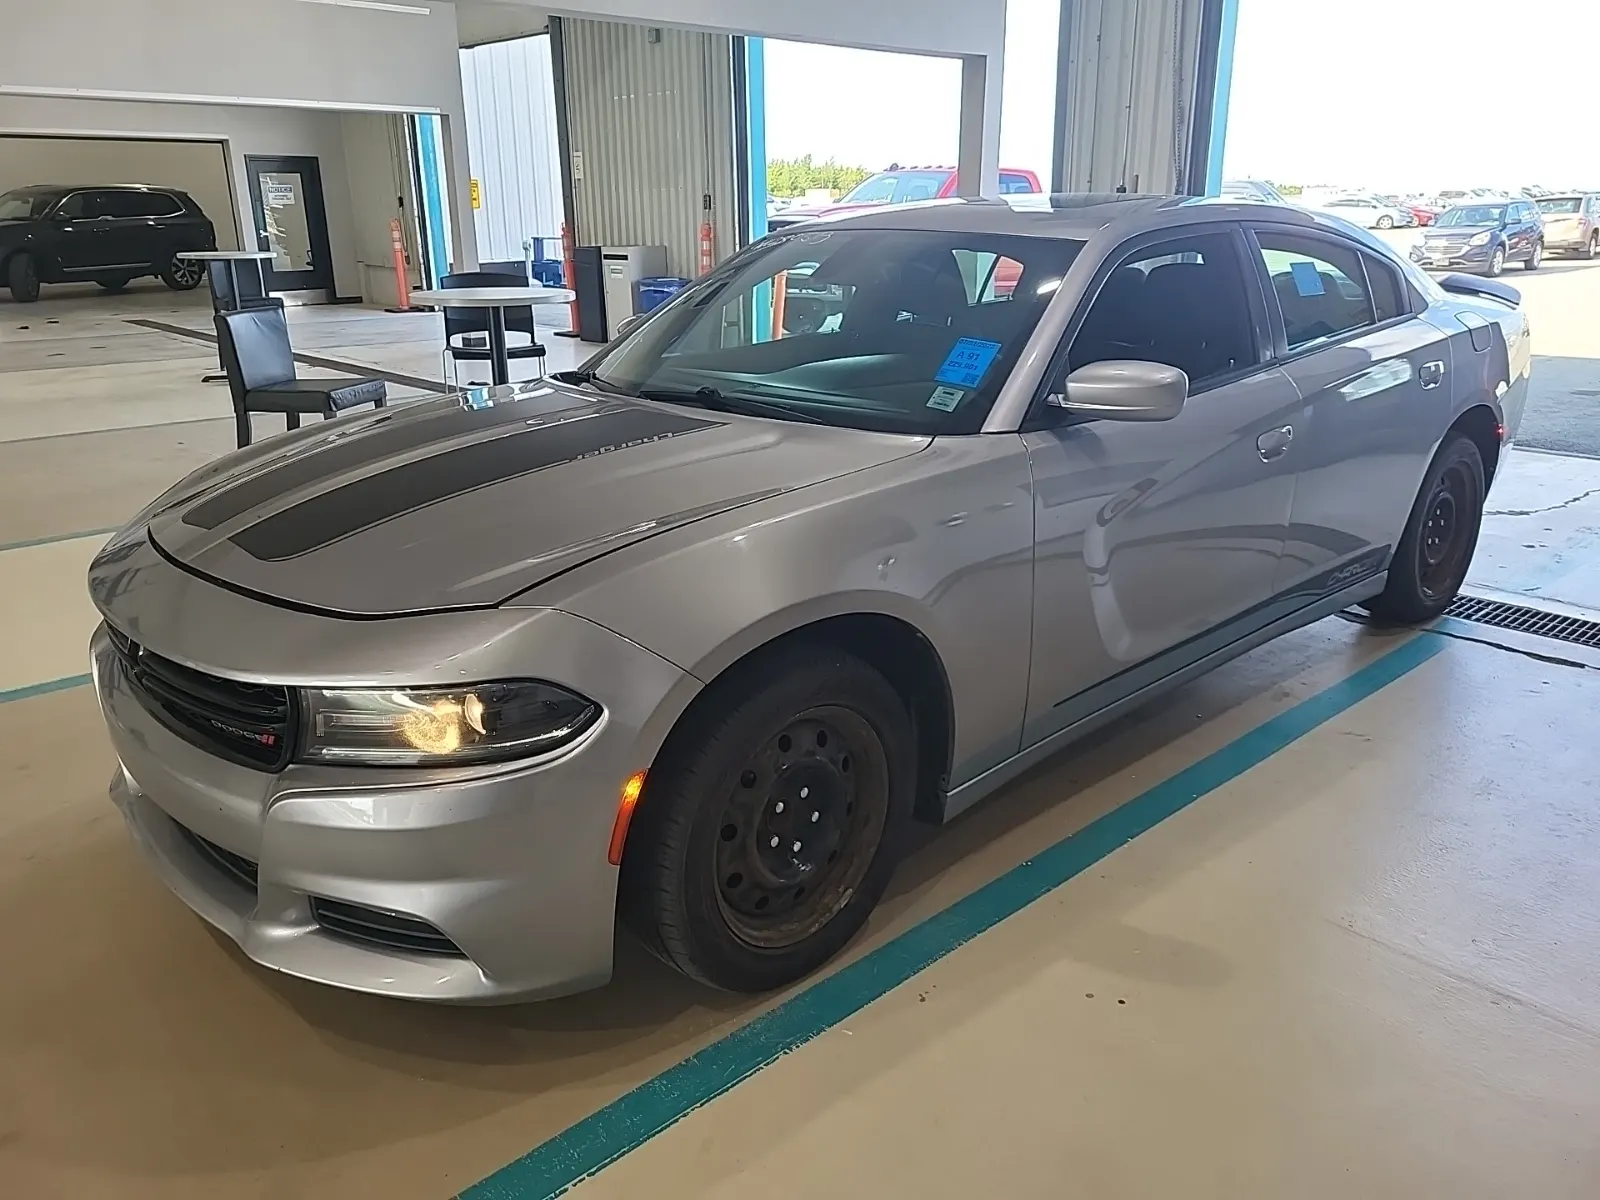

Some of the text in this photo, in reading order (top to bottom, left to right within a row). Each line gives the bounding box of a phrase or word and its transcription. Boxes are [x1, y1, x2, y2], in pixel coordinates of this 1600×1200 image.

[956, 351, 981, 361] A 91
[211, 719, 263, 742] DODGE
